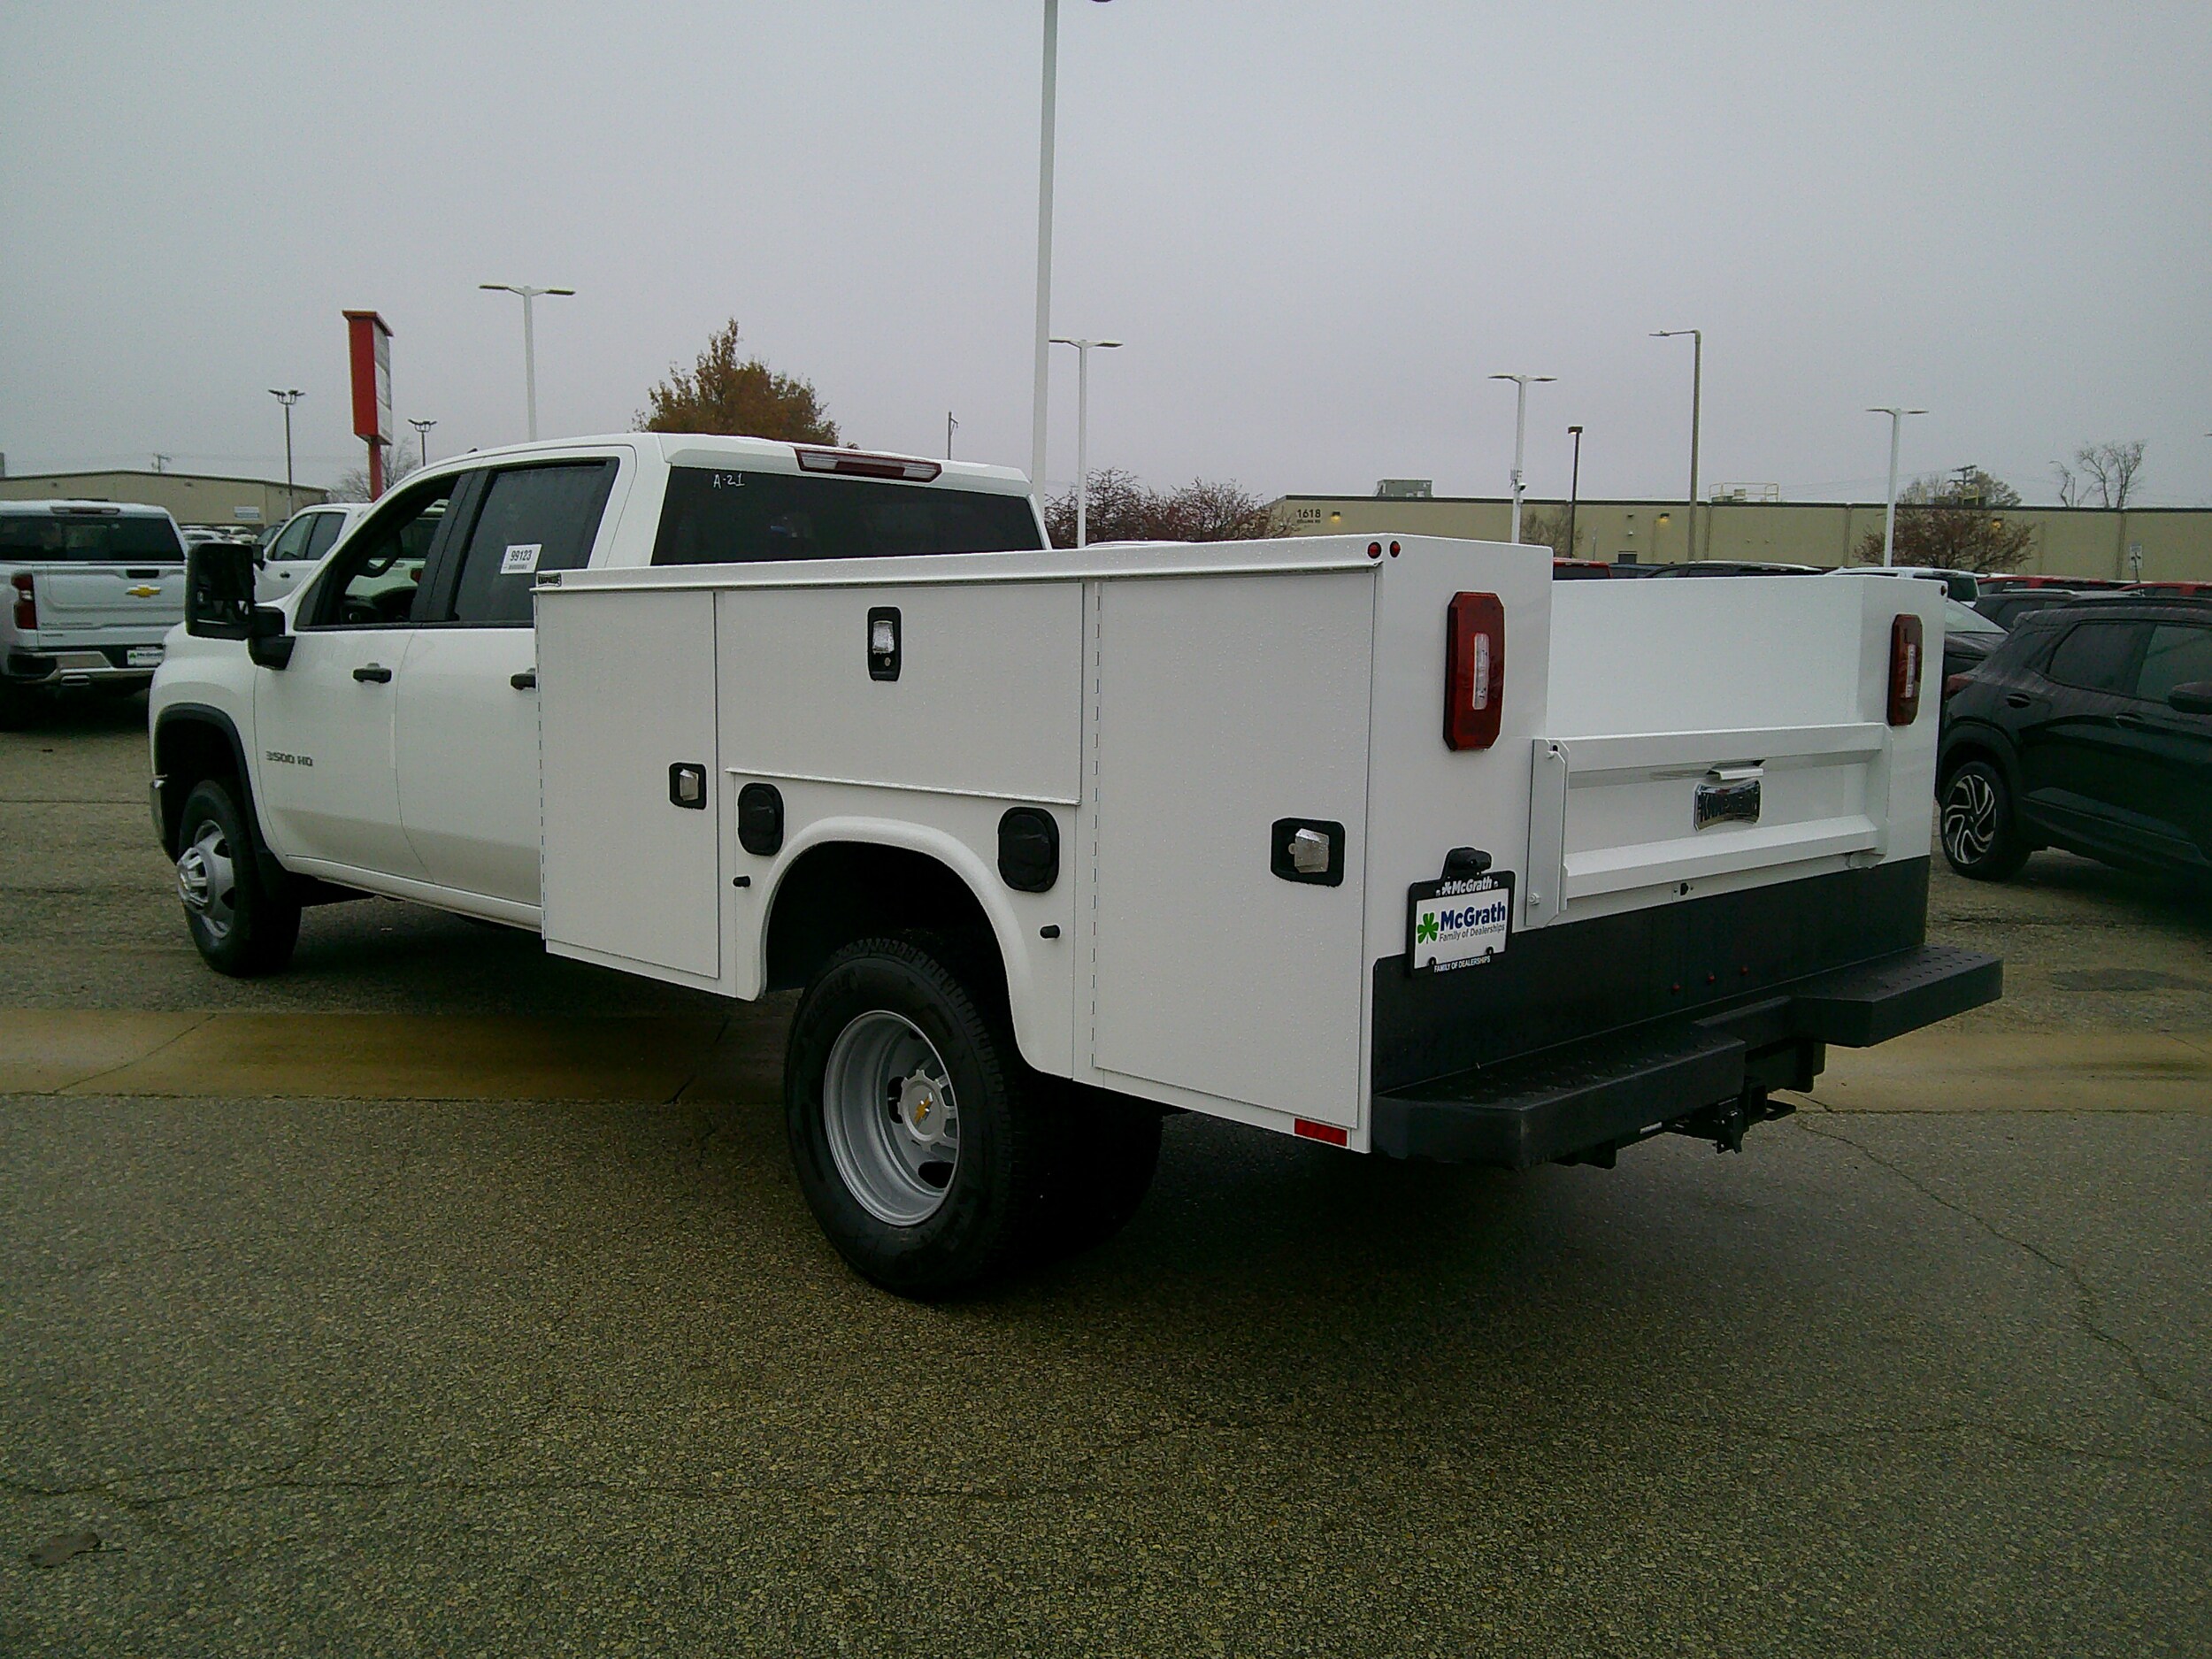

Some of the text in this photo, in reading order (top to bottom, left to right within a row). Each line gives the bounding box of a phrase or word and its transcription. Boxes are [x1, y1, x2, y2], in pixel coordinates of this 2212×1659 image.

[713, 472, 745, 489] A-21
[1296, 509, 1321, 518] 1618
[510, 549, 533, 562] 99123
[265, 751, 313, 767] 3500 HD
[1451, 876, 1493, 895] McGrath
[1440, 902, 1506, 932] McGrath
[1439, 923, 1505, 942] Family of Dealerships
[1433, 956, 1491, 972] FAMILY OF DEALERSHIPS
